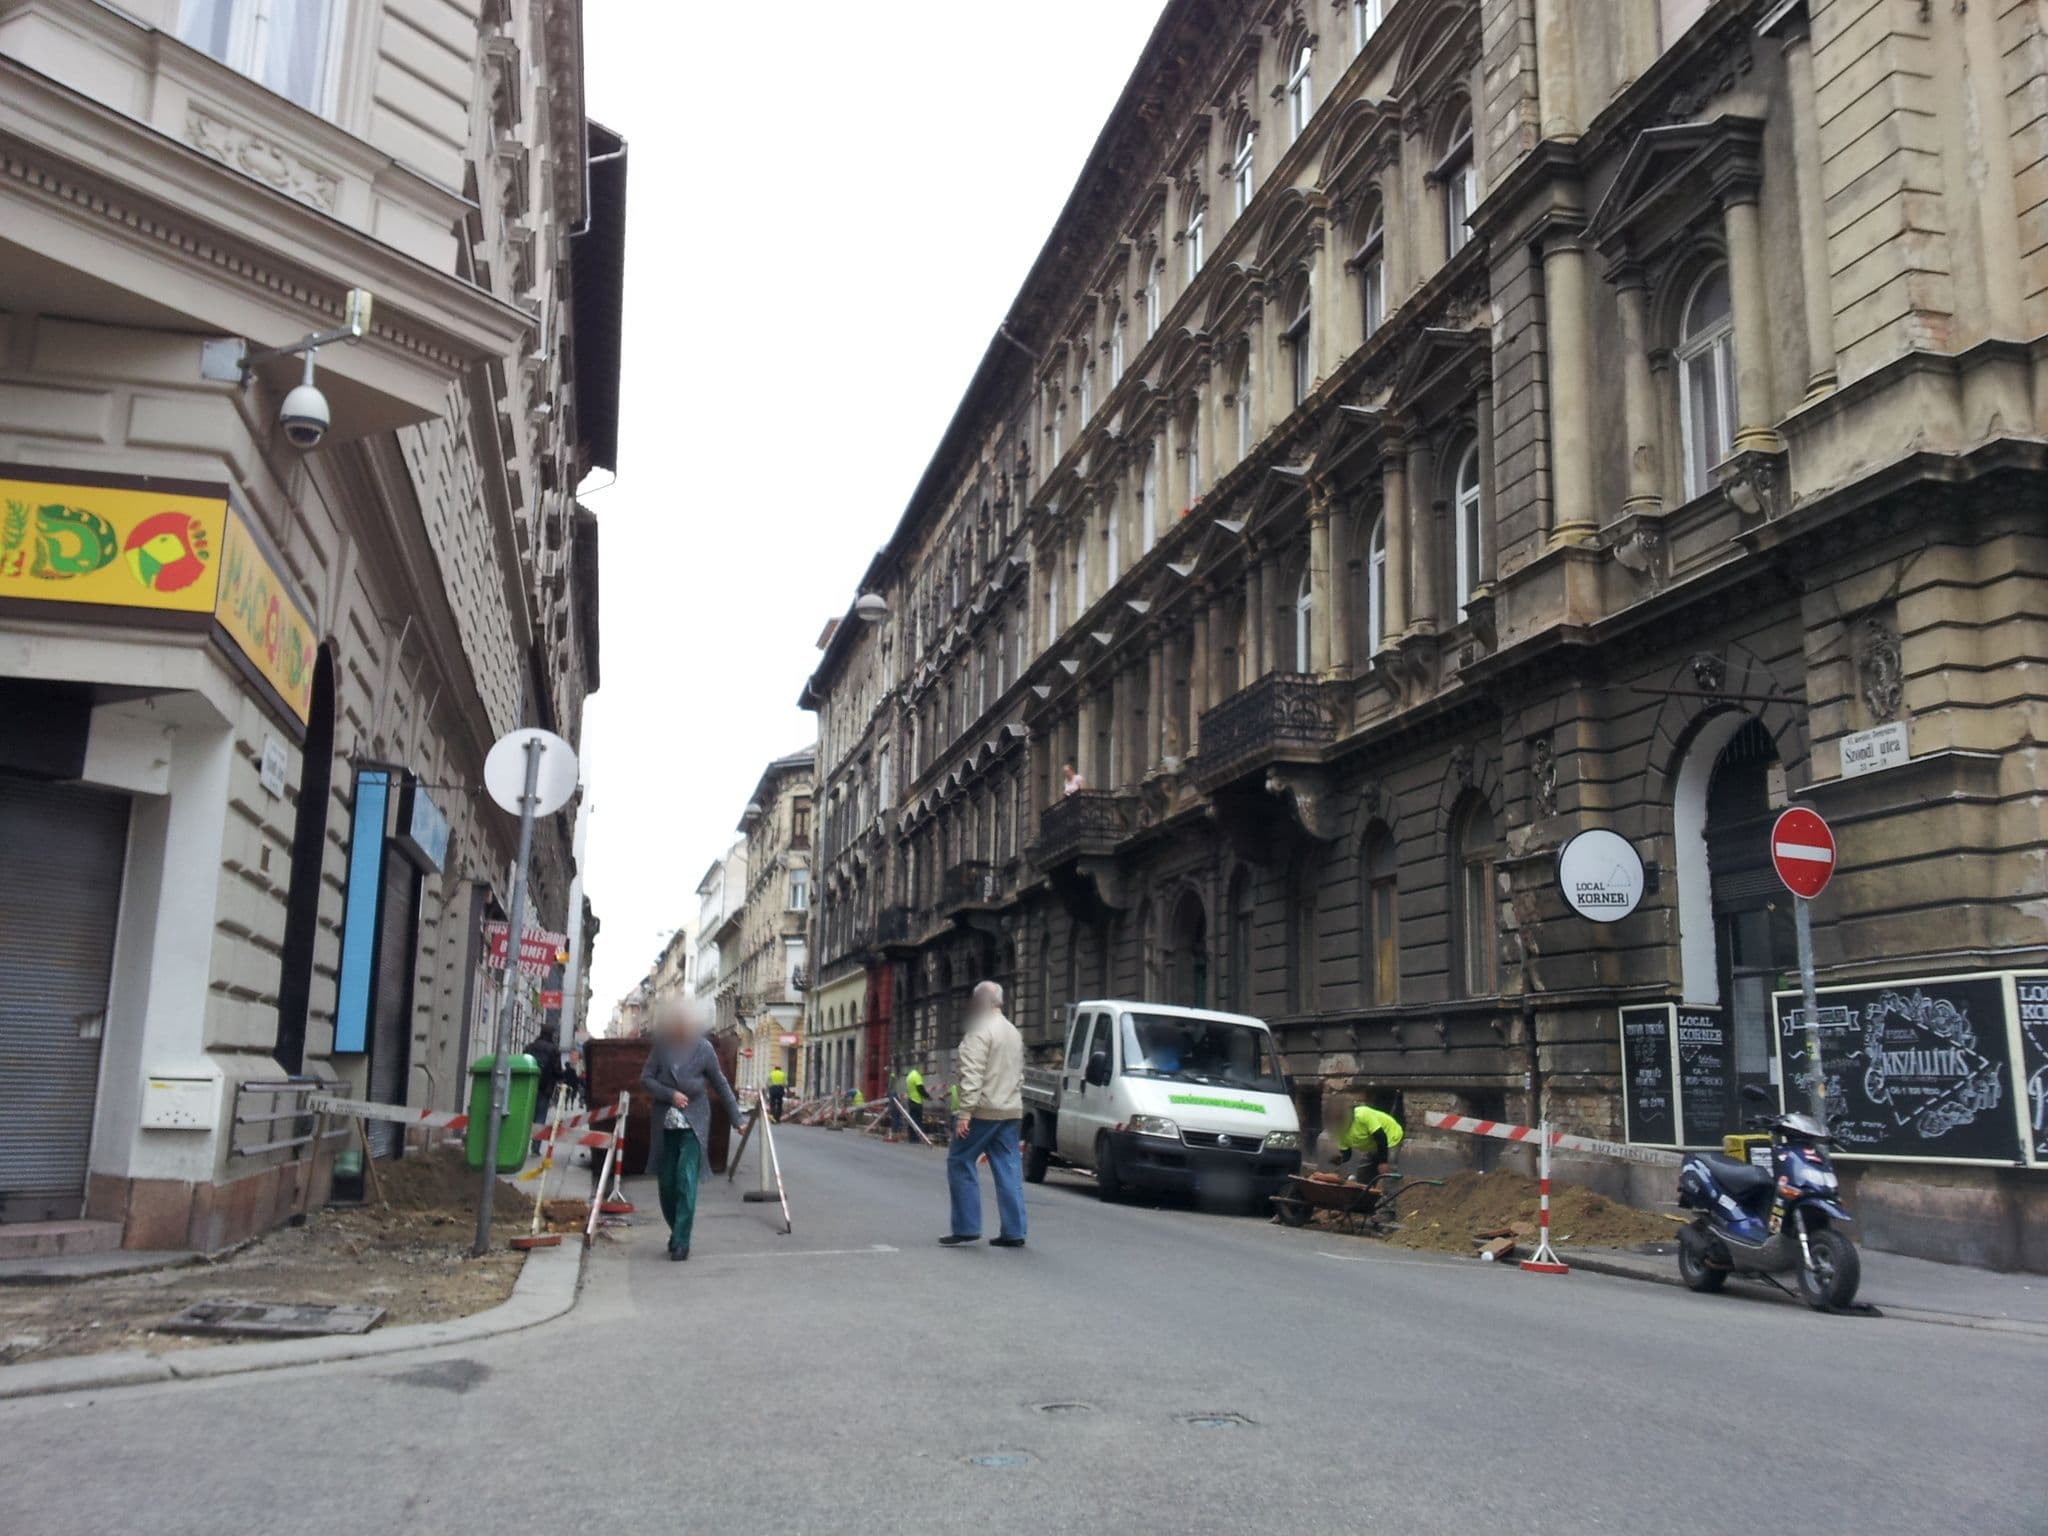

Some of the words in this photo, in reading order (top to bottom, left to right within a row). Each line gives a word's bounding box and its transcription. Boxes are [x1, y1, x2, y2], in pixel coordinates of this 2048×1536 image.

[1845, 742, 1874, 764] Szondi
[1880, 740, 1901, 755] utca
[1576, 882, 1605, 891] LOCAL
[1577, 893, 1626, 904] KORNER
[1679, 1015, 1713, 1026] LOCAL
[1679, 1028, 1722, 1042] KORNER
[1881, 1046, 1969, 1076] KISZÁLLÍTÁS
